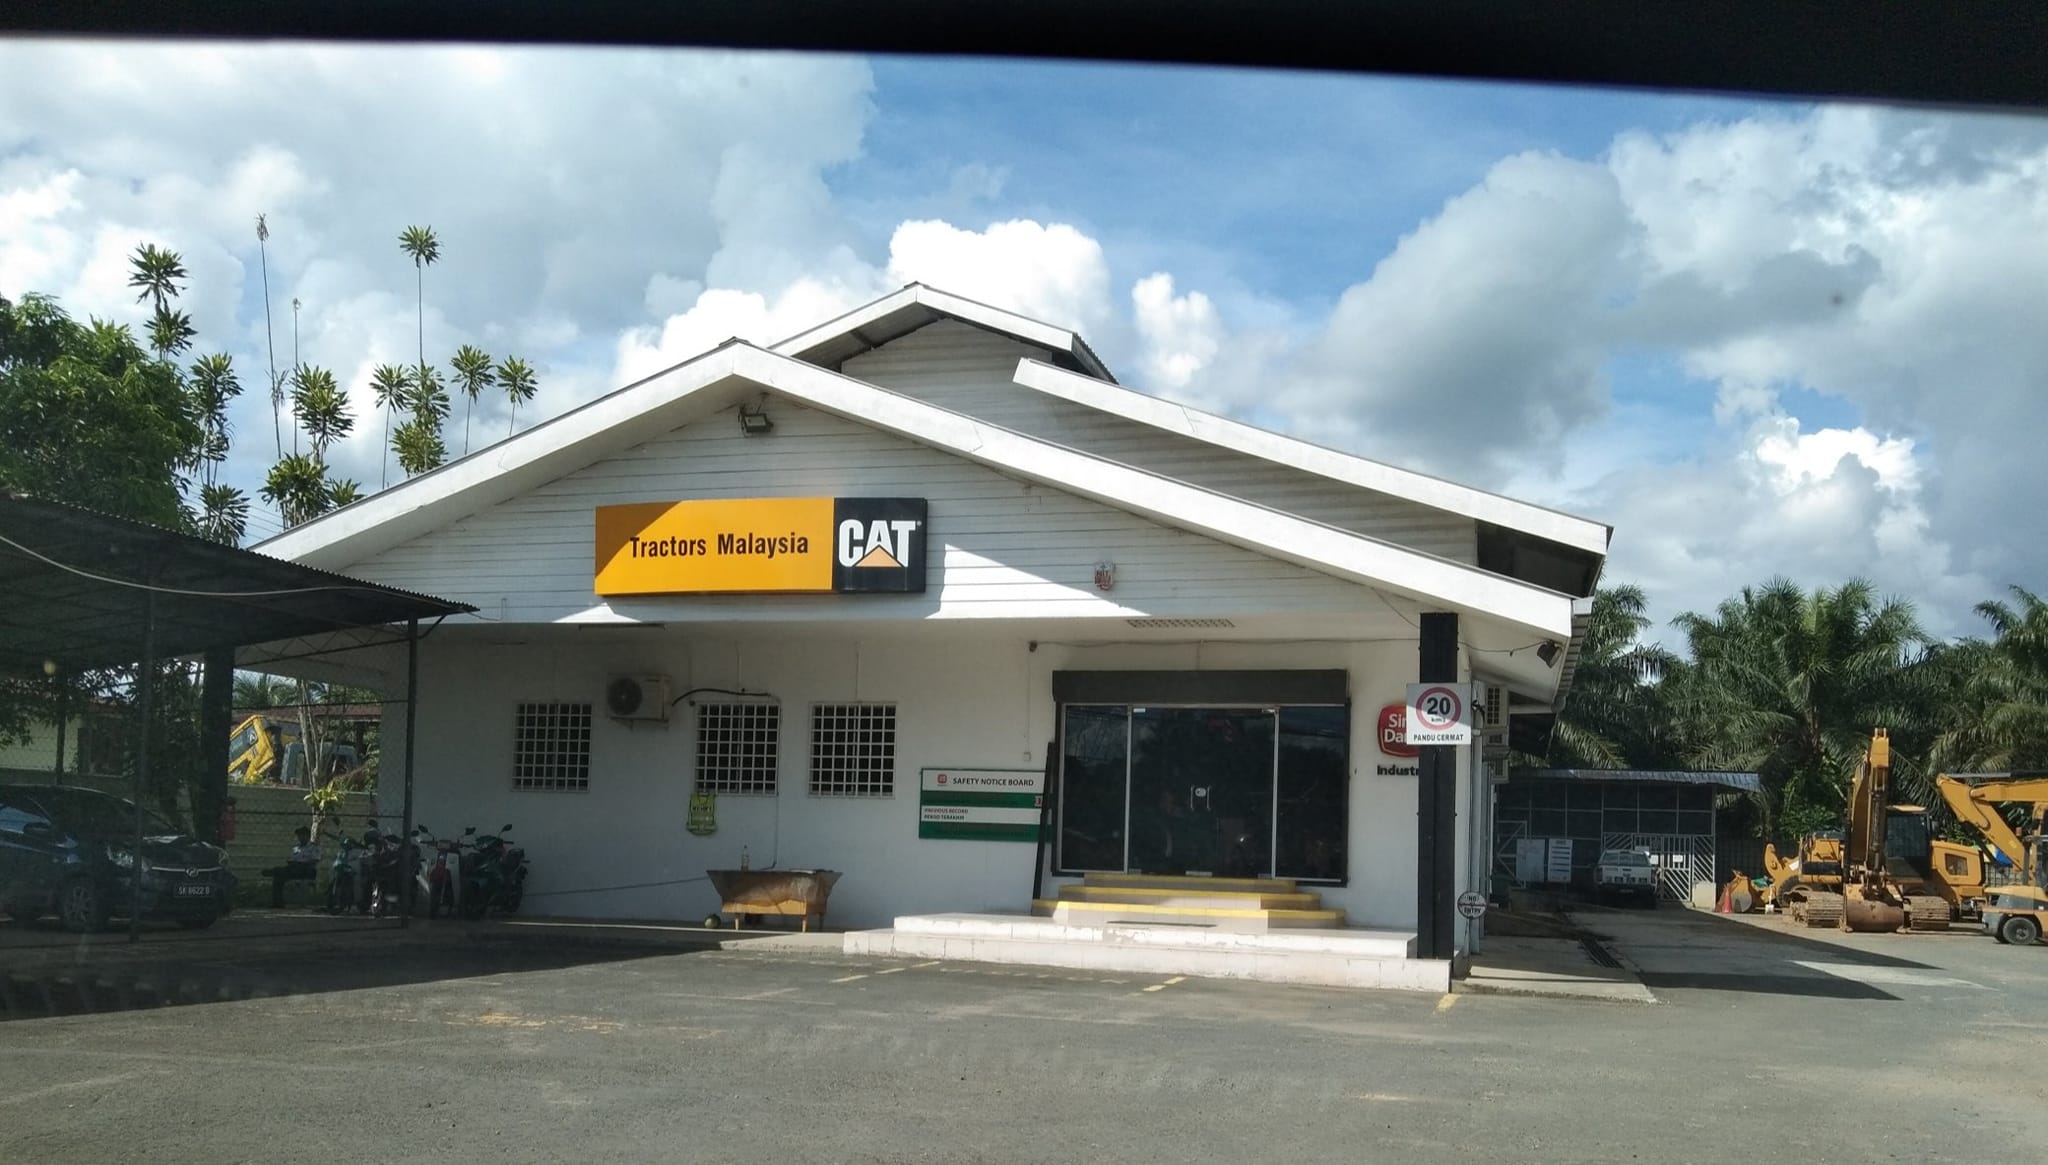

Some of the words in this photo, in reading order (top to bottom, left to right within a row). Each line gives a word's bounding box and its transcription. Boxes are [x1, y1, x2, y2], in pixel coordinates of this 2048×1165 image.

[630, 536, 707, 558] Tractors
[717, 532, 809, 559] Malaysia
[838, 519, 917, 567] CAT
[1427, 697, 1451, 715] 20
[1413, 734, 1436, 742] PANDU
[1436, 734, 1464, 742] CERMAT
[952, 777, 980, 785] SAFETY
[980, 778, 1007, 786] NOTICE
[1007, 779, 1034, 787] BOARD
